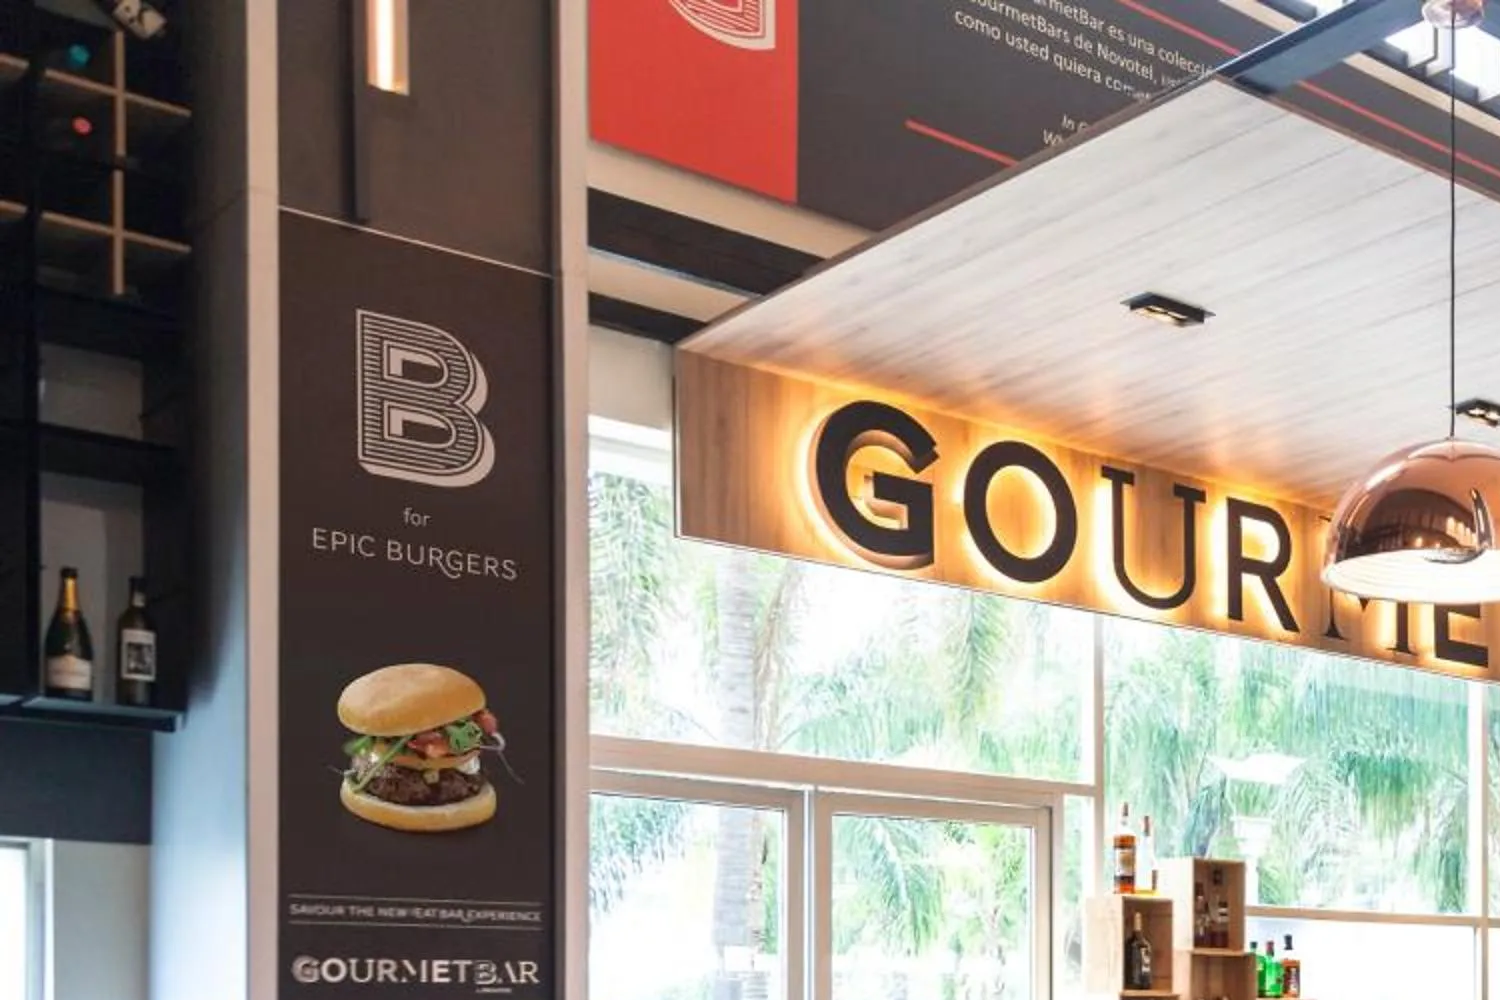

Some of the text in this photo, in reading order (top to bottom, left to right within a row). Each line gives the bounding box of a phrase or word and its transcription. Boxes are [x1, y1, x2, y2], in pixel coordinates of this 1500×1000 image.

[954, 10, 1000, 40] como
[1005, 31, 1049, 60] usted
[1053, 51, 1101, 83] quiera
[1073, 32, 1093, 54] de
[356, 308, 495, 488] B
[403, 507, 431, 527] for
[312, 527, 518, 581] EPIC BURGERS
